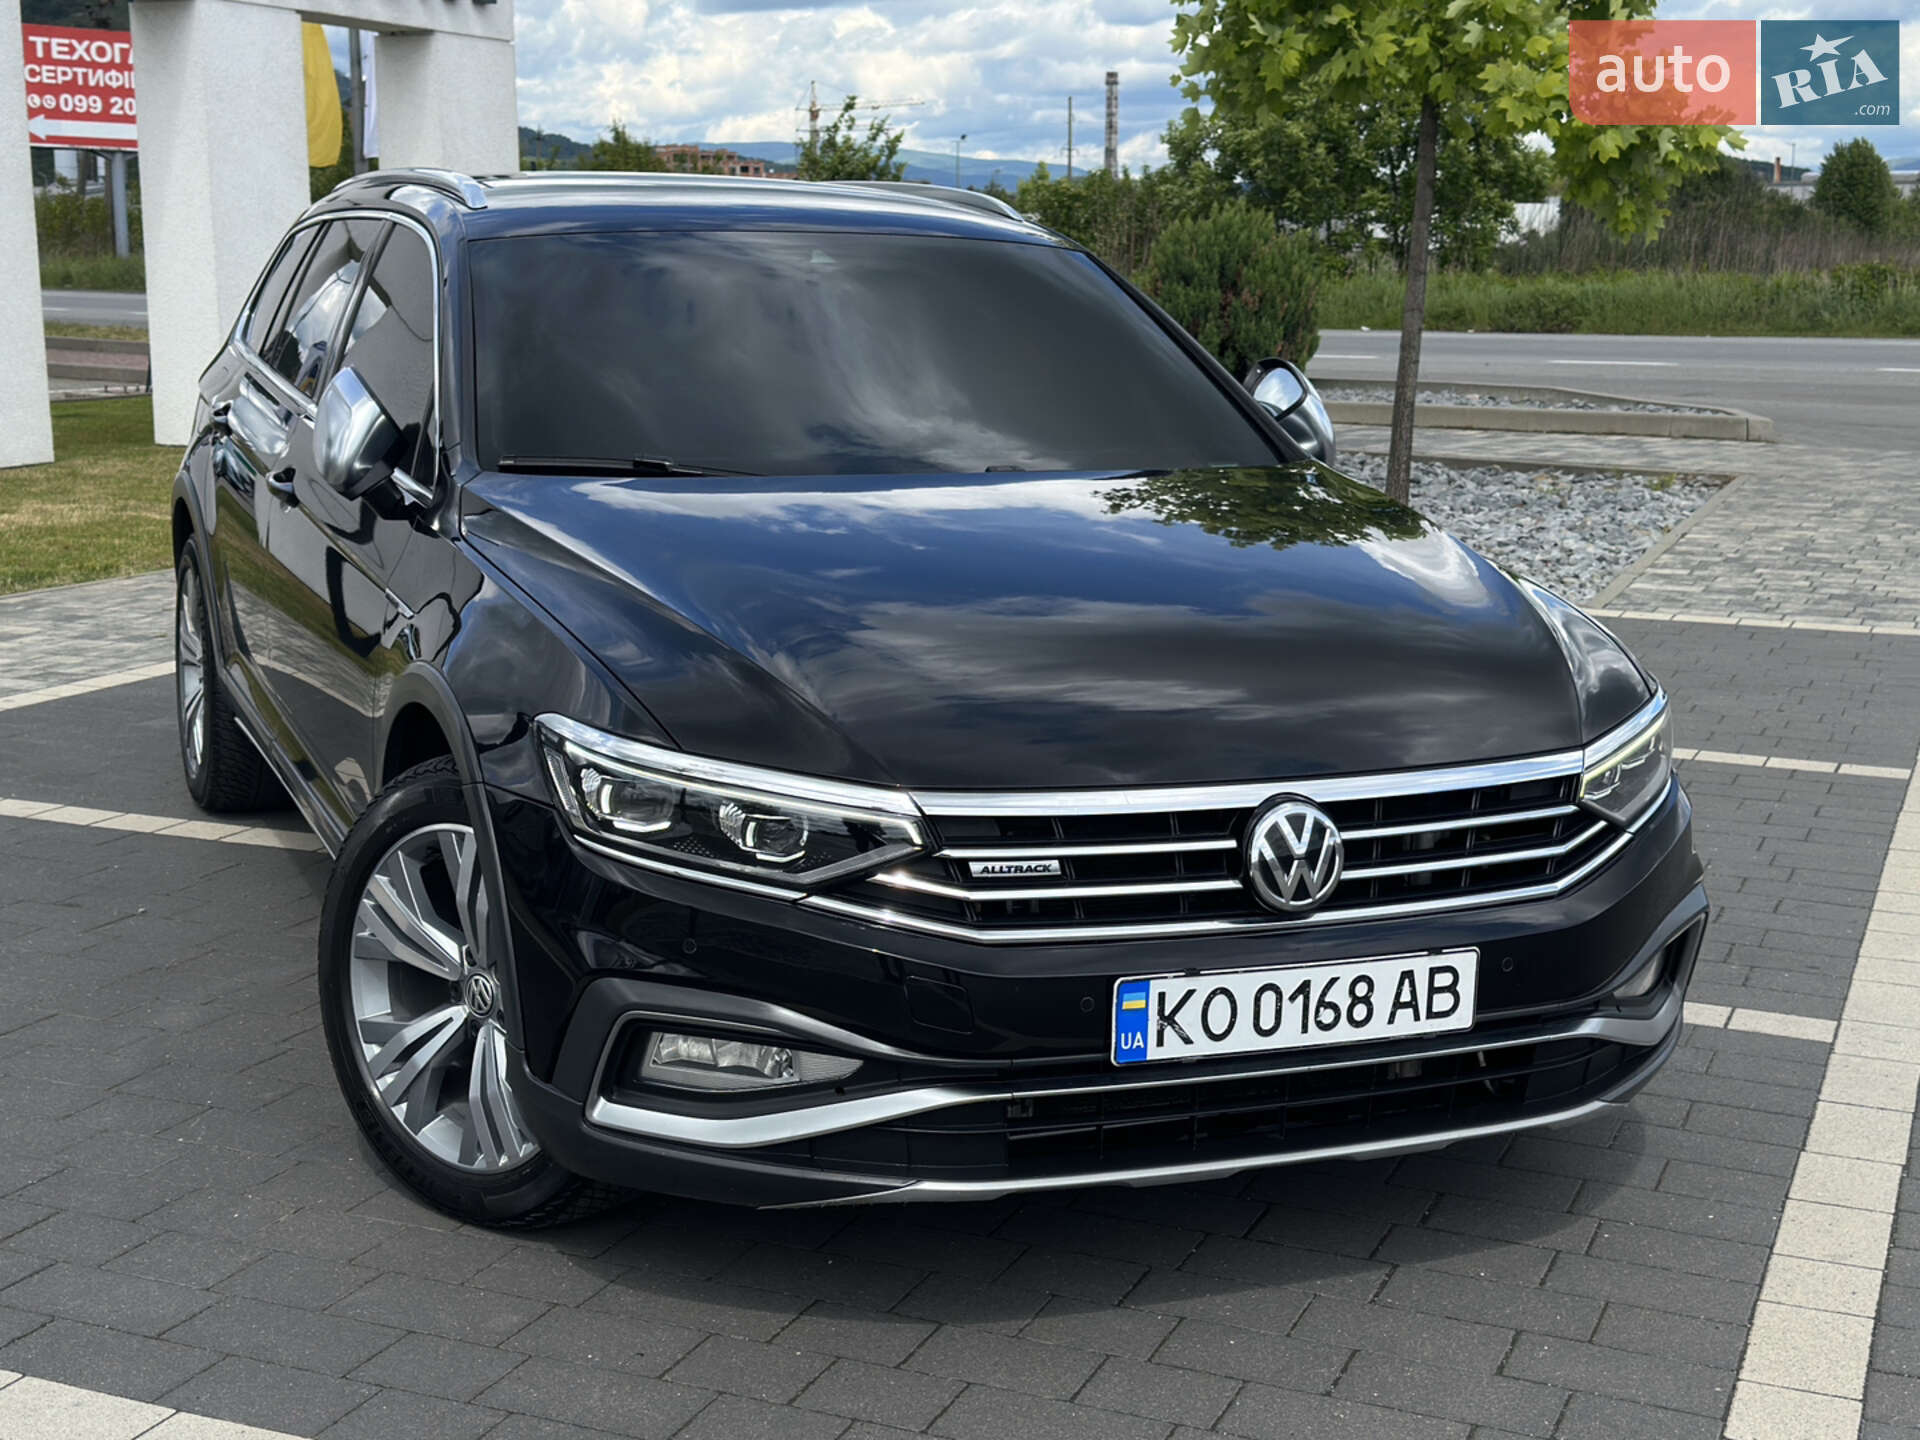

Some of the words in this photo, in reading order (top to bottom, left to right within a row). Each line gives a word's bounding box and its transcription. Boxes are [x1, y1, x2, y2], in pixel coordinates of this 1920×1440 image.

[59, 94, 103, 114] 099
[980, 864, 1052, 874] ALLTRACK
[1156, 986, 1238, 1048] KO
[1252, 974, 1375, 1038] 0168
[1387, 964, 1461, 1025] AB
[1120, 1031, 1145, 1050] UA
